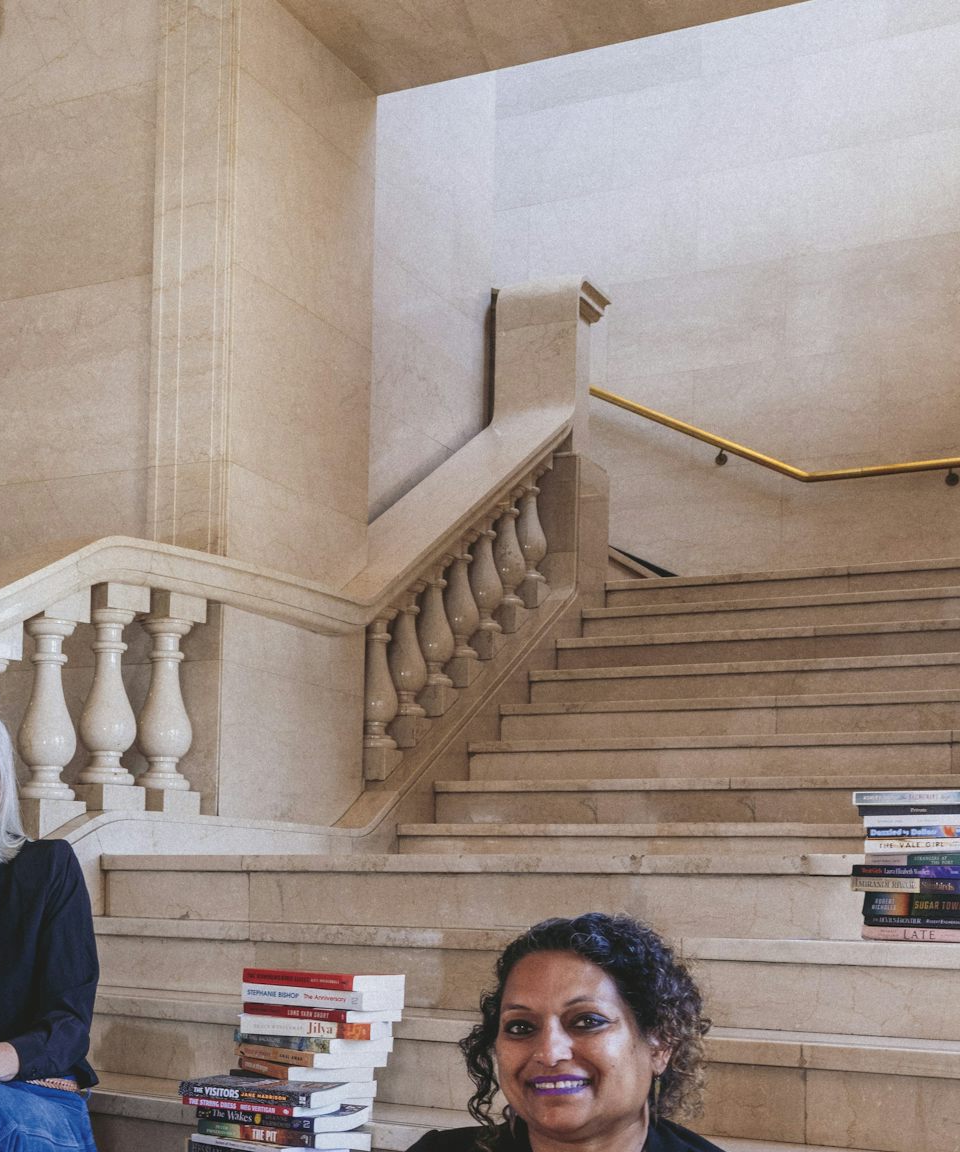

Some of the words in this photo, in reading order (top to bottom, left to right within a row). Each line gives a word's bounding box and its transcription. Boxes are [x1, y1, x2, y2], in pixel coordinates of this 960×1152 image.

[914, 901, 939, 910] SUGAR
[903, 928, 936, 940] LATE
[247, 988, 277, 998] STEPHANIE
[278, 990, 300, 999] BISHOP
[193, 1086, 203, 1094] THE
[204, 1086, 240, 1099] VISITORS
[257, 1093, 287, 1101] HARRISON
[212, 1109, 225, 1118] The
[226, 1108, 253, 1123] Wakes
[252, 1129, 265, 1141] THE
[265, 1130, 278, 1143] PIT
